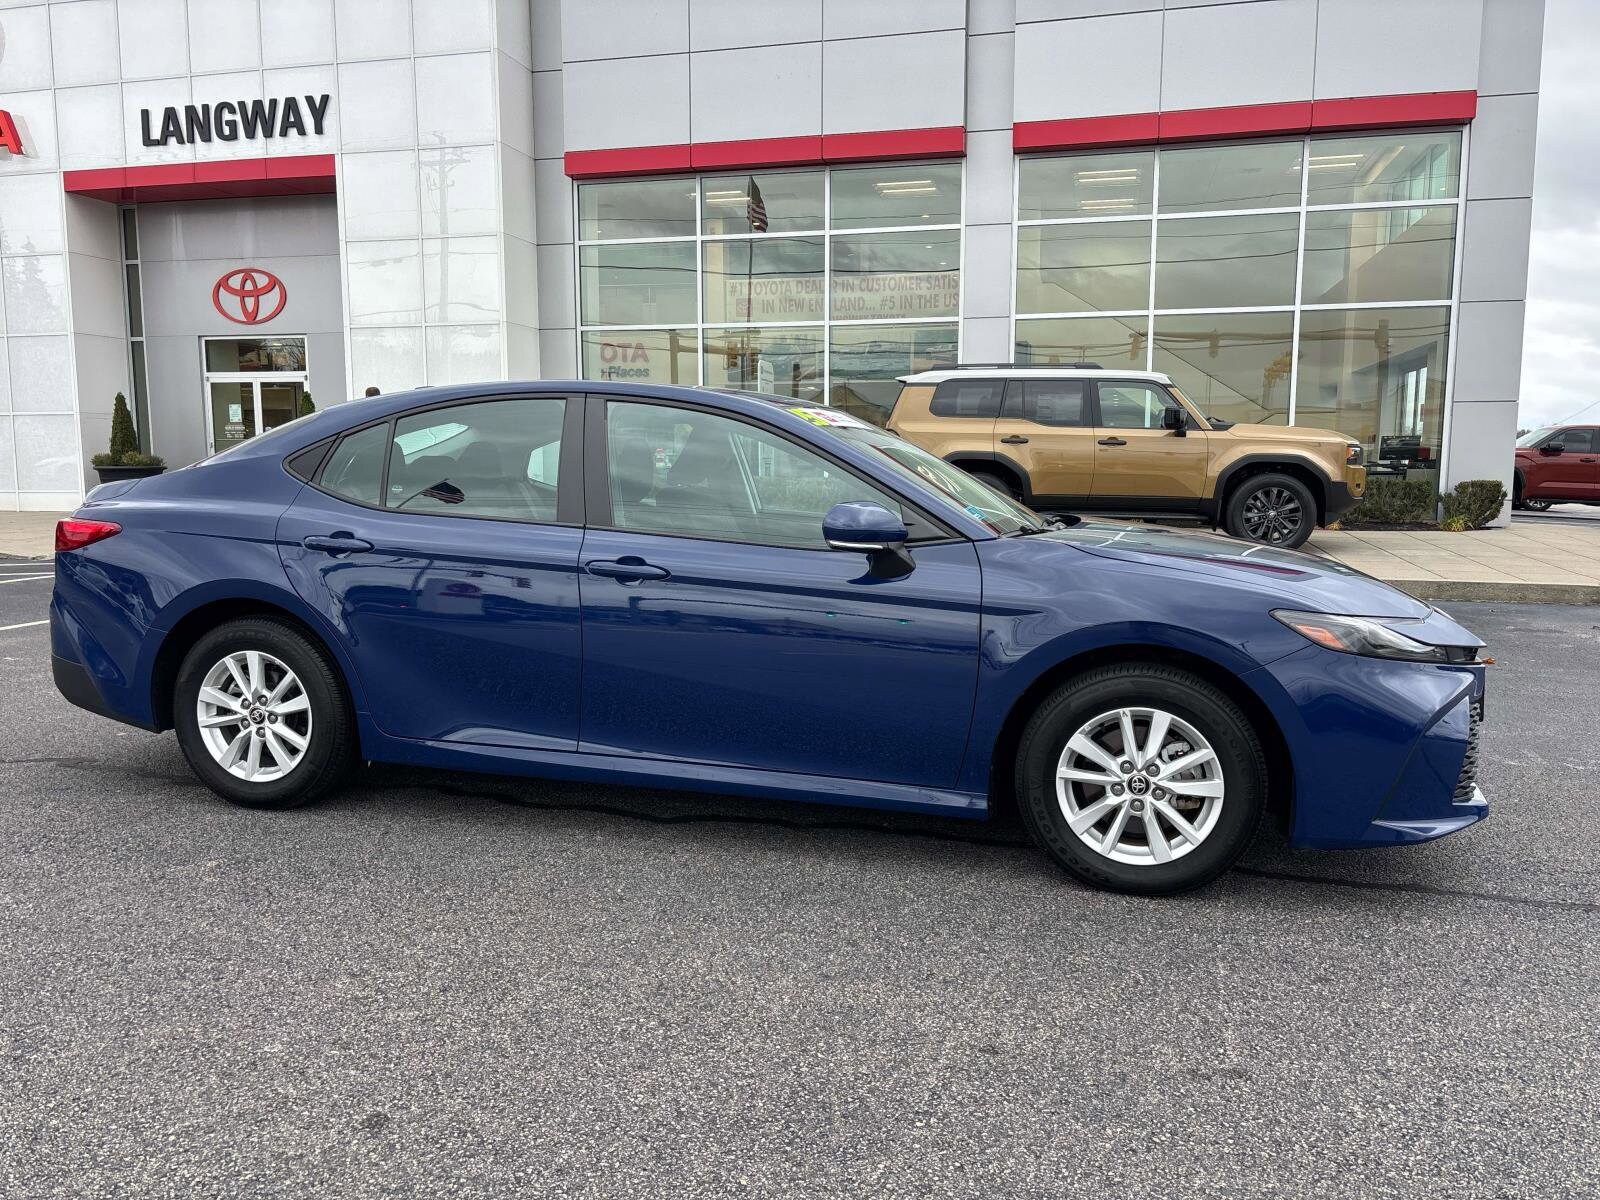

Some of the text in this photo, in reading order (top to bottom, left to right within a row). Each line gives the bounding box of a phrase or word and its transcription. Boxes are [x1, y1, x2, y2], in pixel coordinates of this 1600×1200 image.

[140, 94, 330, 147] LANGWAY
[729, 281, 743, 297] #1
[748, 280, 792, 296] OYOTA
[796, 278, 838, 295] DEALR
[841, 279, 855, 293] IN
[860, 276, 921, 293] CUSTOMER
[761, 299, 775, 313] IN
[779, 299, 804, 313] NEW
[808, 297, 876, 313] ENLAND...
[880, 295, 895, 311] #5
[899, 294, 912, 309] IN
[918, 293, 940, 309] THE
[608, 365, 650, 378] Places
